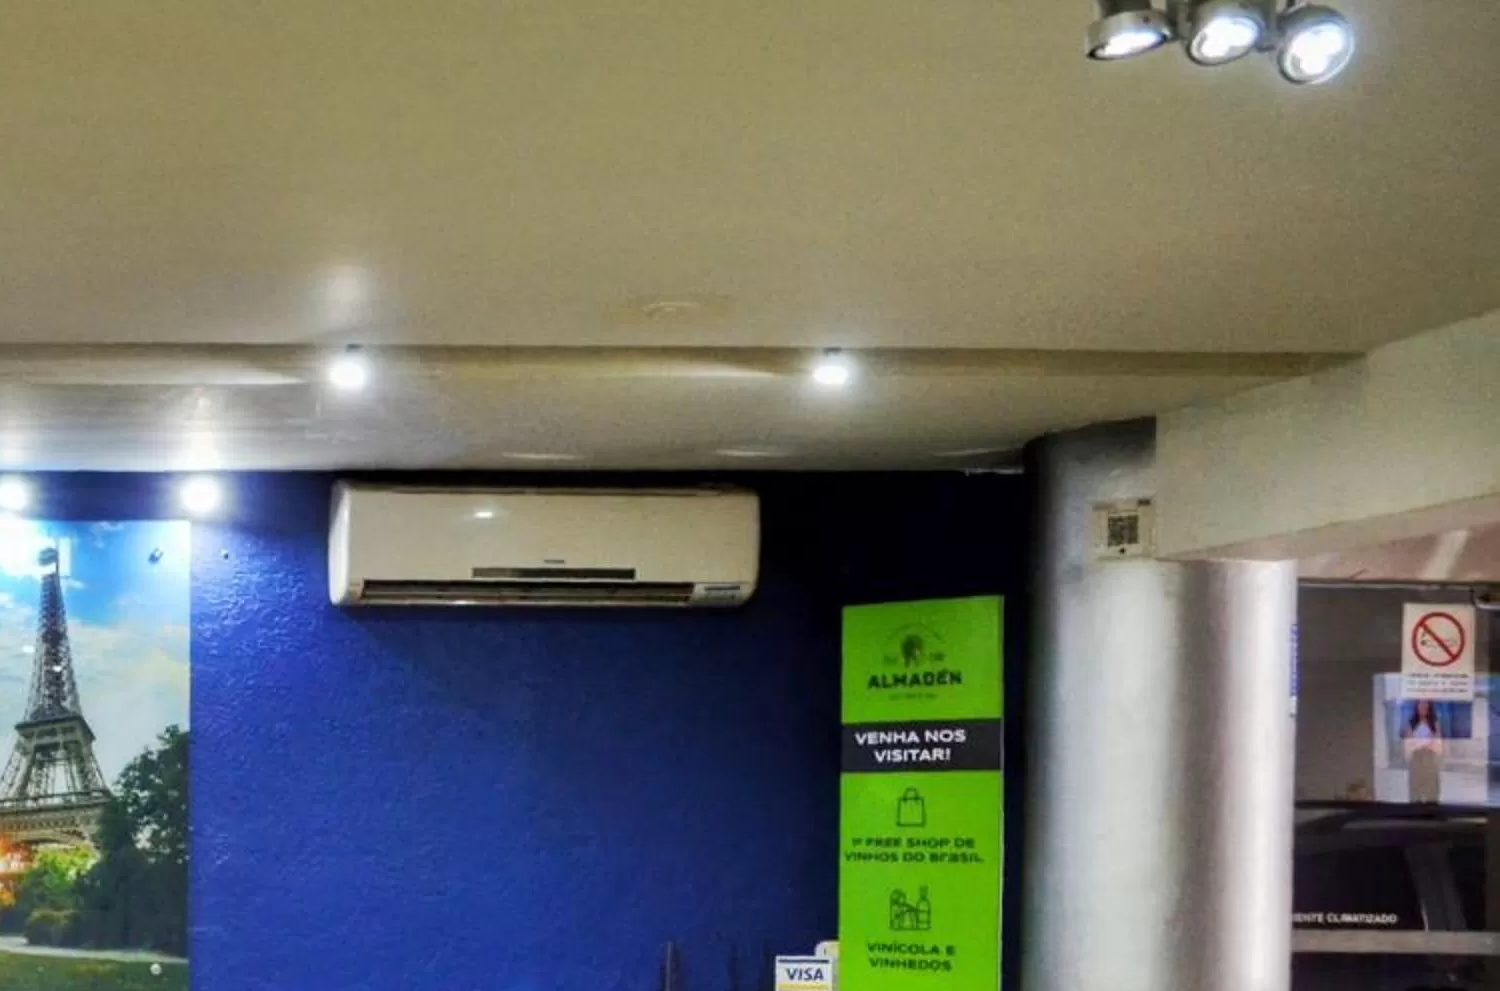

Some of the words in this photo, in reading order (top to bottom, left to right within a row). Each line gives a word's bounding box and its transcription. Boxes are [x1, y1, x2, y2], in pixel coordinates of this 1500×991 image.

[867, 668, 963, 690] ALMADÉN
[854, 731, 920, 745] VENHA
[924, 728, 967, 743] NOS
[873, 748, 952, 763] VISITAR!
[865, 837, 902, 848] FREE
[907, 837, 950, 849] SHOP
[954, 838, 975, 849] DE
[844, 852, 898, 863] VINHOS
[902, 852, 926, 863] DO
[867, 941, 941, 956] VINÍCOLA
[945, 945, 956, 956] E
[868, 957, 953, 971] VINHEDOS
[786, 967, 824, 981] VISA
